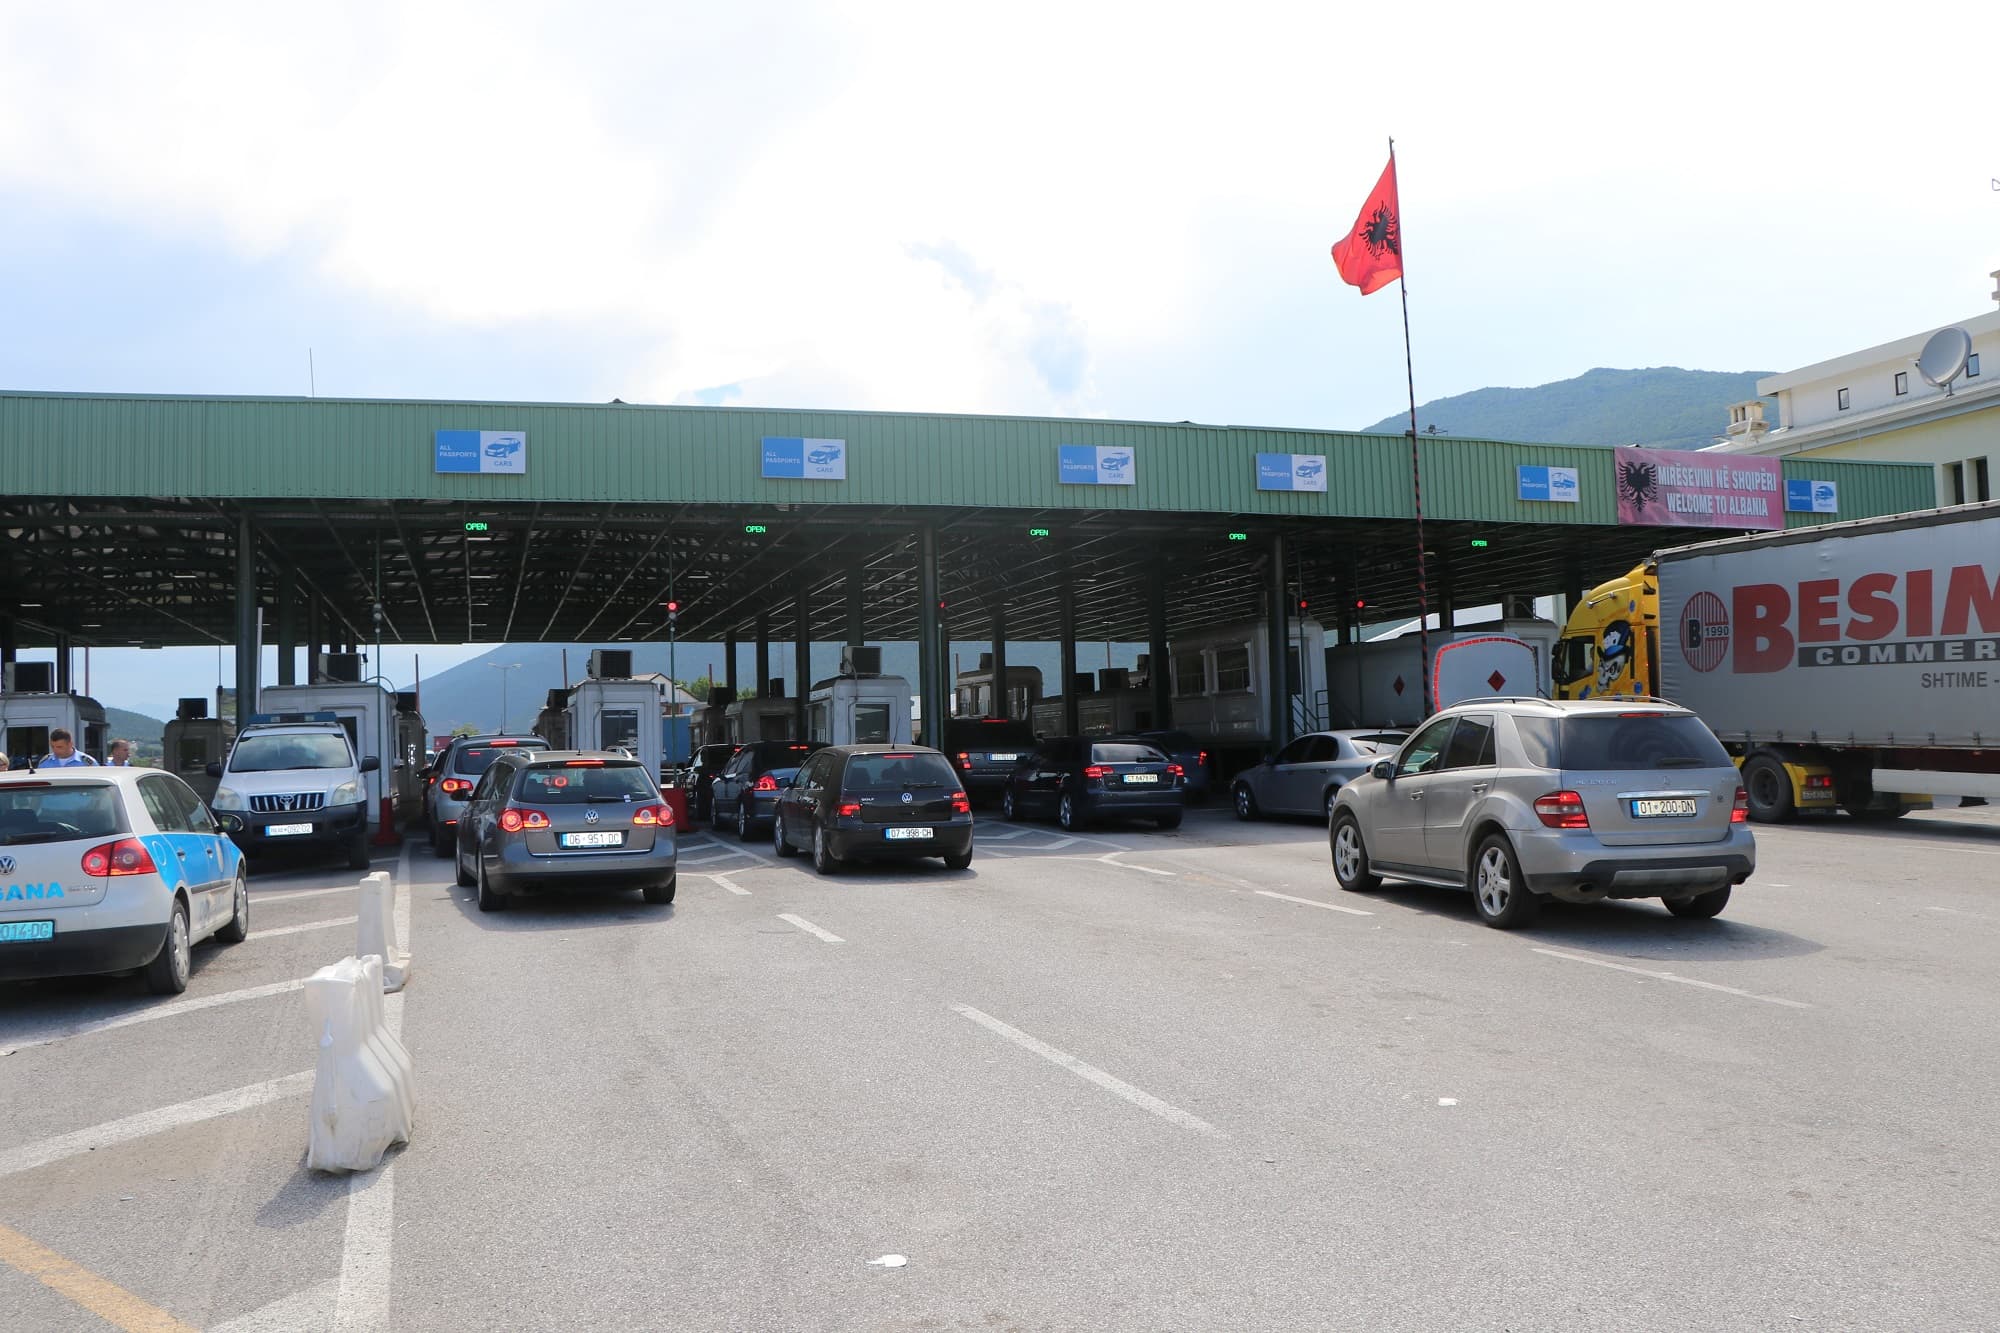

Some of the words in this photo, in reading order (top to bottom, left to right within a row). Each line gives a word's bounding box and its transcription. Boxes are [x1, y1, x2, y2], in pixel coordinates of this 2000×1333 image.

[1657, 462, 1713, 488] MIRËSEVINI
[1716, 465, 1729, 489] NË
[1731, 467, 1777, 492] SHQIPËRI
[1666, 492, 1713, 514] WELCOME
[1715, 495, 1727, 515] TO
[1729, 496, 1768, 517] ALBANIA
[465, 522, 488, 531] OPEN
[745, 525, 766, 533] OPEN
[1030, 528, 1049, 536] OPEN
[1704, 624, 1730, 637] 1990
[1815, 640, 1998, 665] COMMER
[1921, 671, 1989, 689] SHTIME
[1640, 801, 1652, 814] 01
[569, 834, 581, 845] 06
[891, 828, 900, 838] 07
